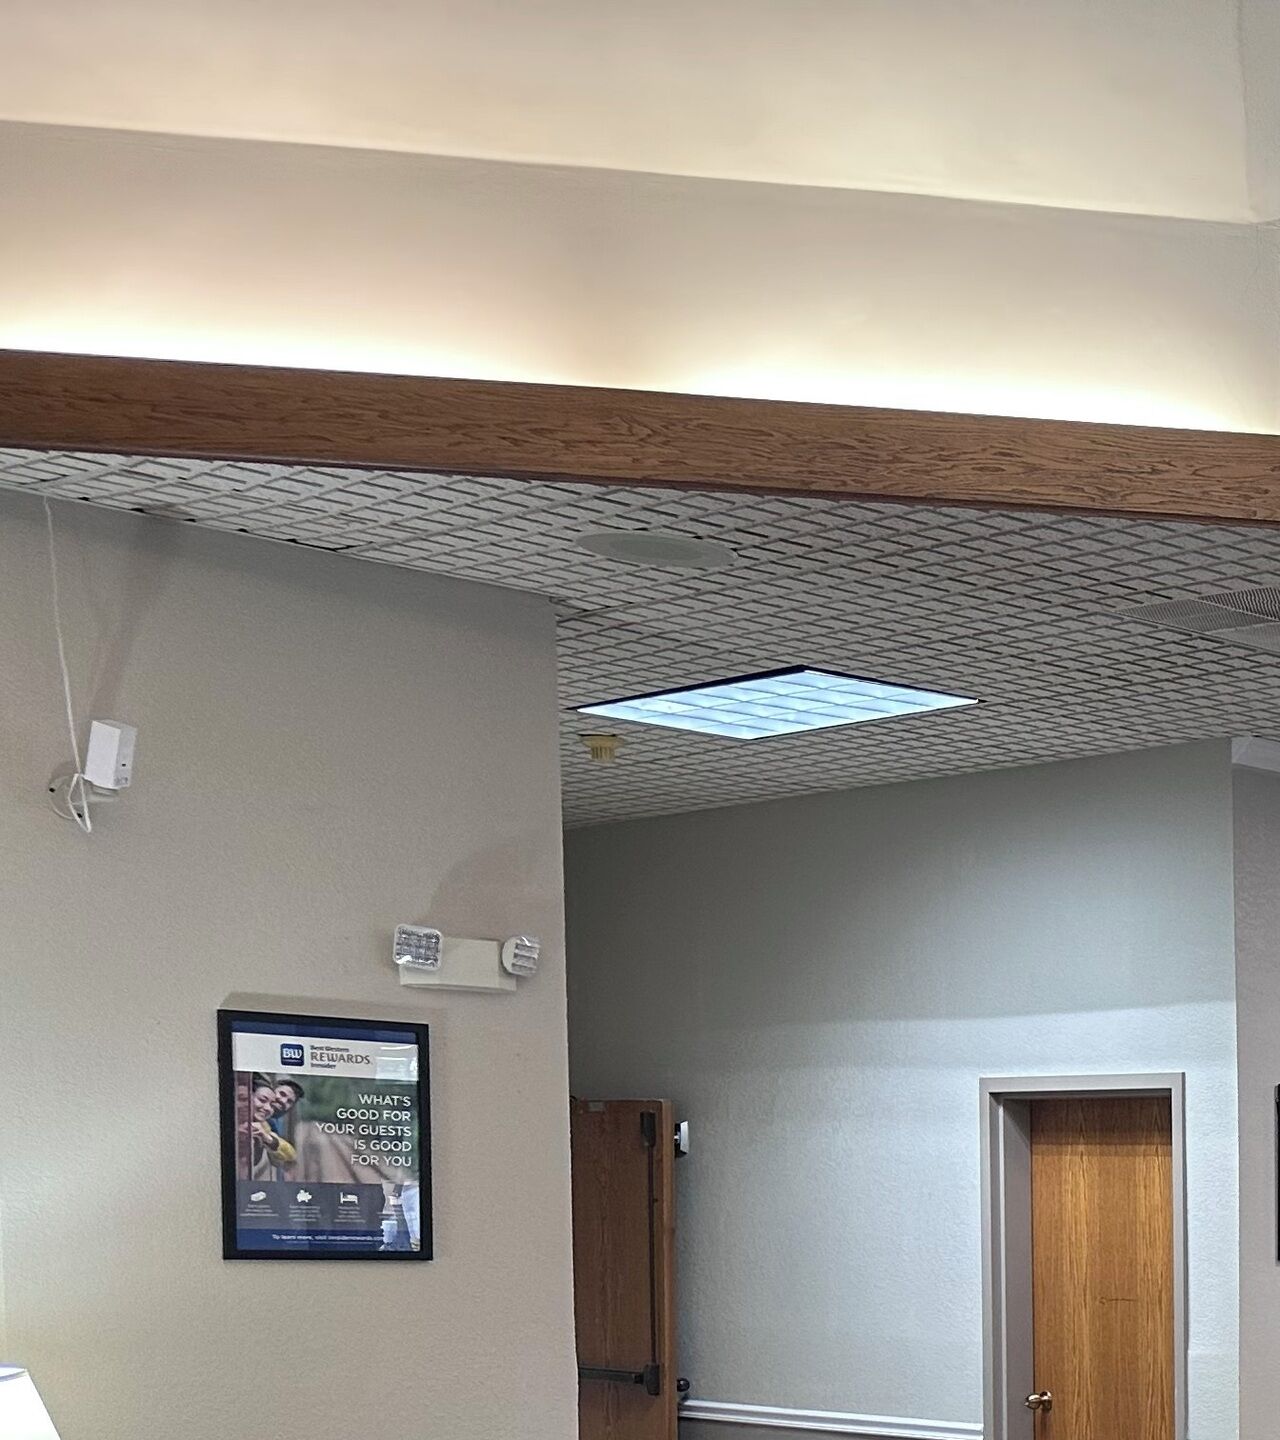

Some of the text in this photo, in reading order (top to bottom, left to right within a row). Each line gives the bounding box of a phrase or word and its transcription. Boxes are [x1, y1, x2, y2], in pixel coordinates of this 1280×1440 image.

[310, 1052, 370, 1064] REWARDS
[358, 1094, 411, 1107] WHAT'S
[337, 1108, 411, 1121] GOOD FOR
[315, 1122, 411, 1136] YOUR GUESTS
[354, 1140, 412, 1152] IS GOOD
[351, 1155, 411, 1166] FOR YOU
